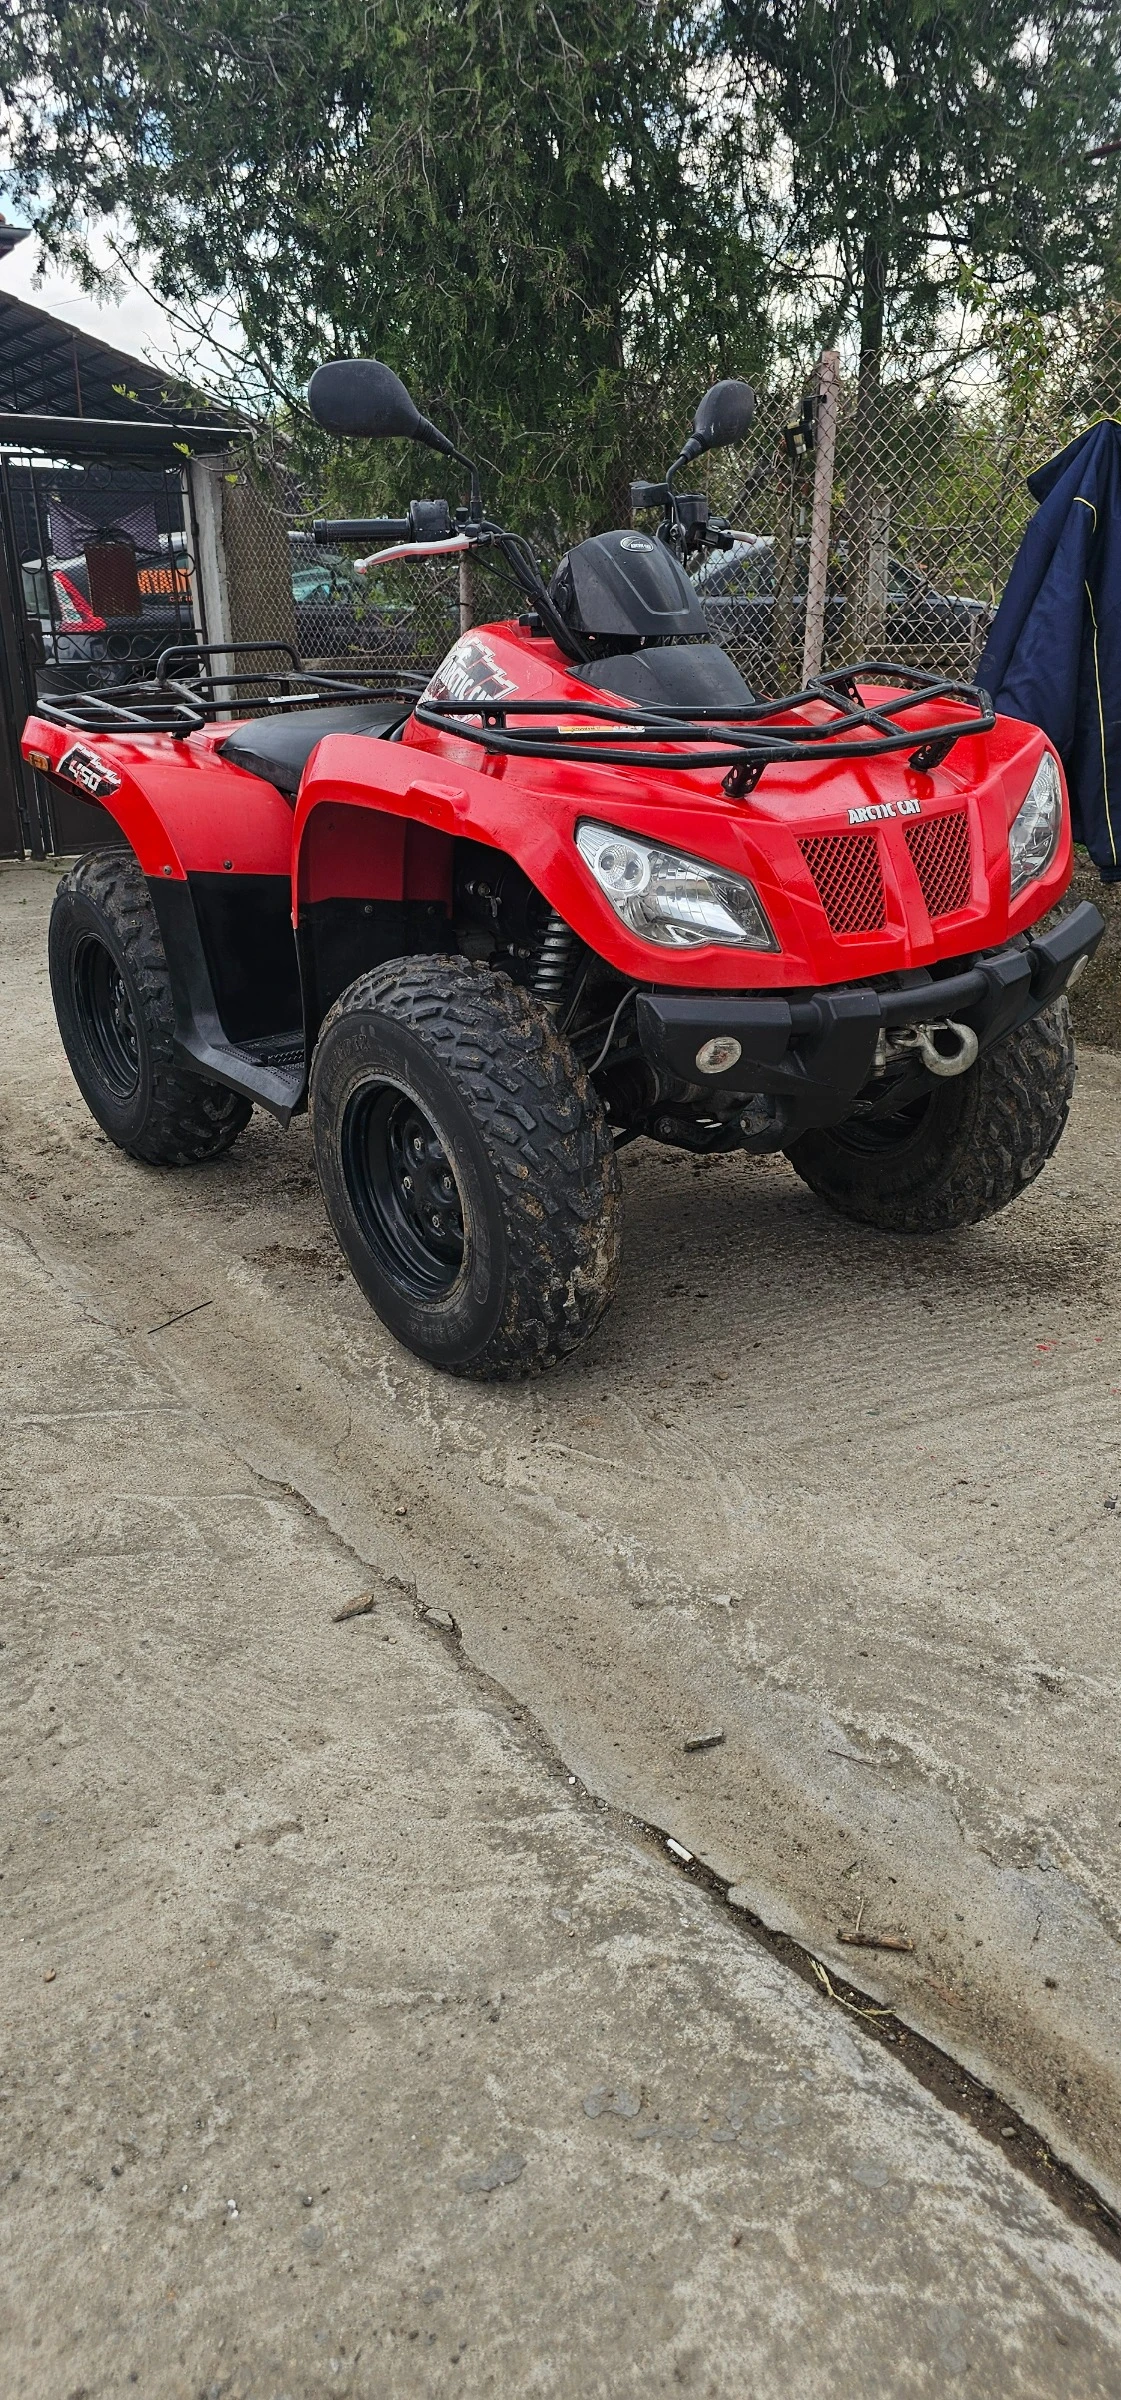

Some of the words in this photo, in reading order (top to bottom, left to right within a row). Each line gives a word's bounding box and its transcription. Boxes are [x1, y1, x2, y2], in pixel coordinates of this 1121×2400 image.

[69, 760, 102, 791] 450
[847, 803, 897, 824] ARCTIC
[896, 799, 921, 815] CAT
